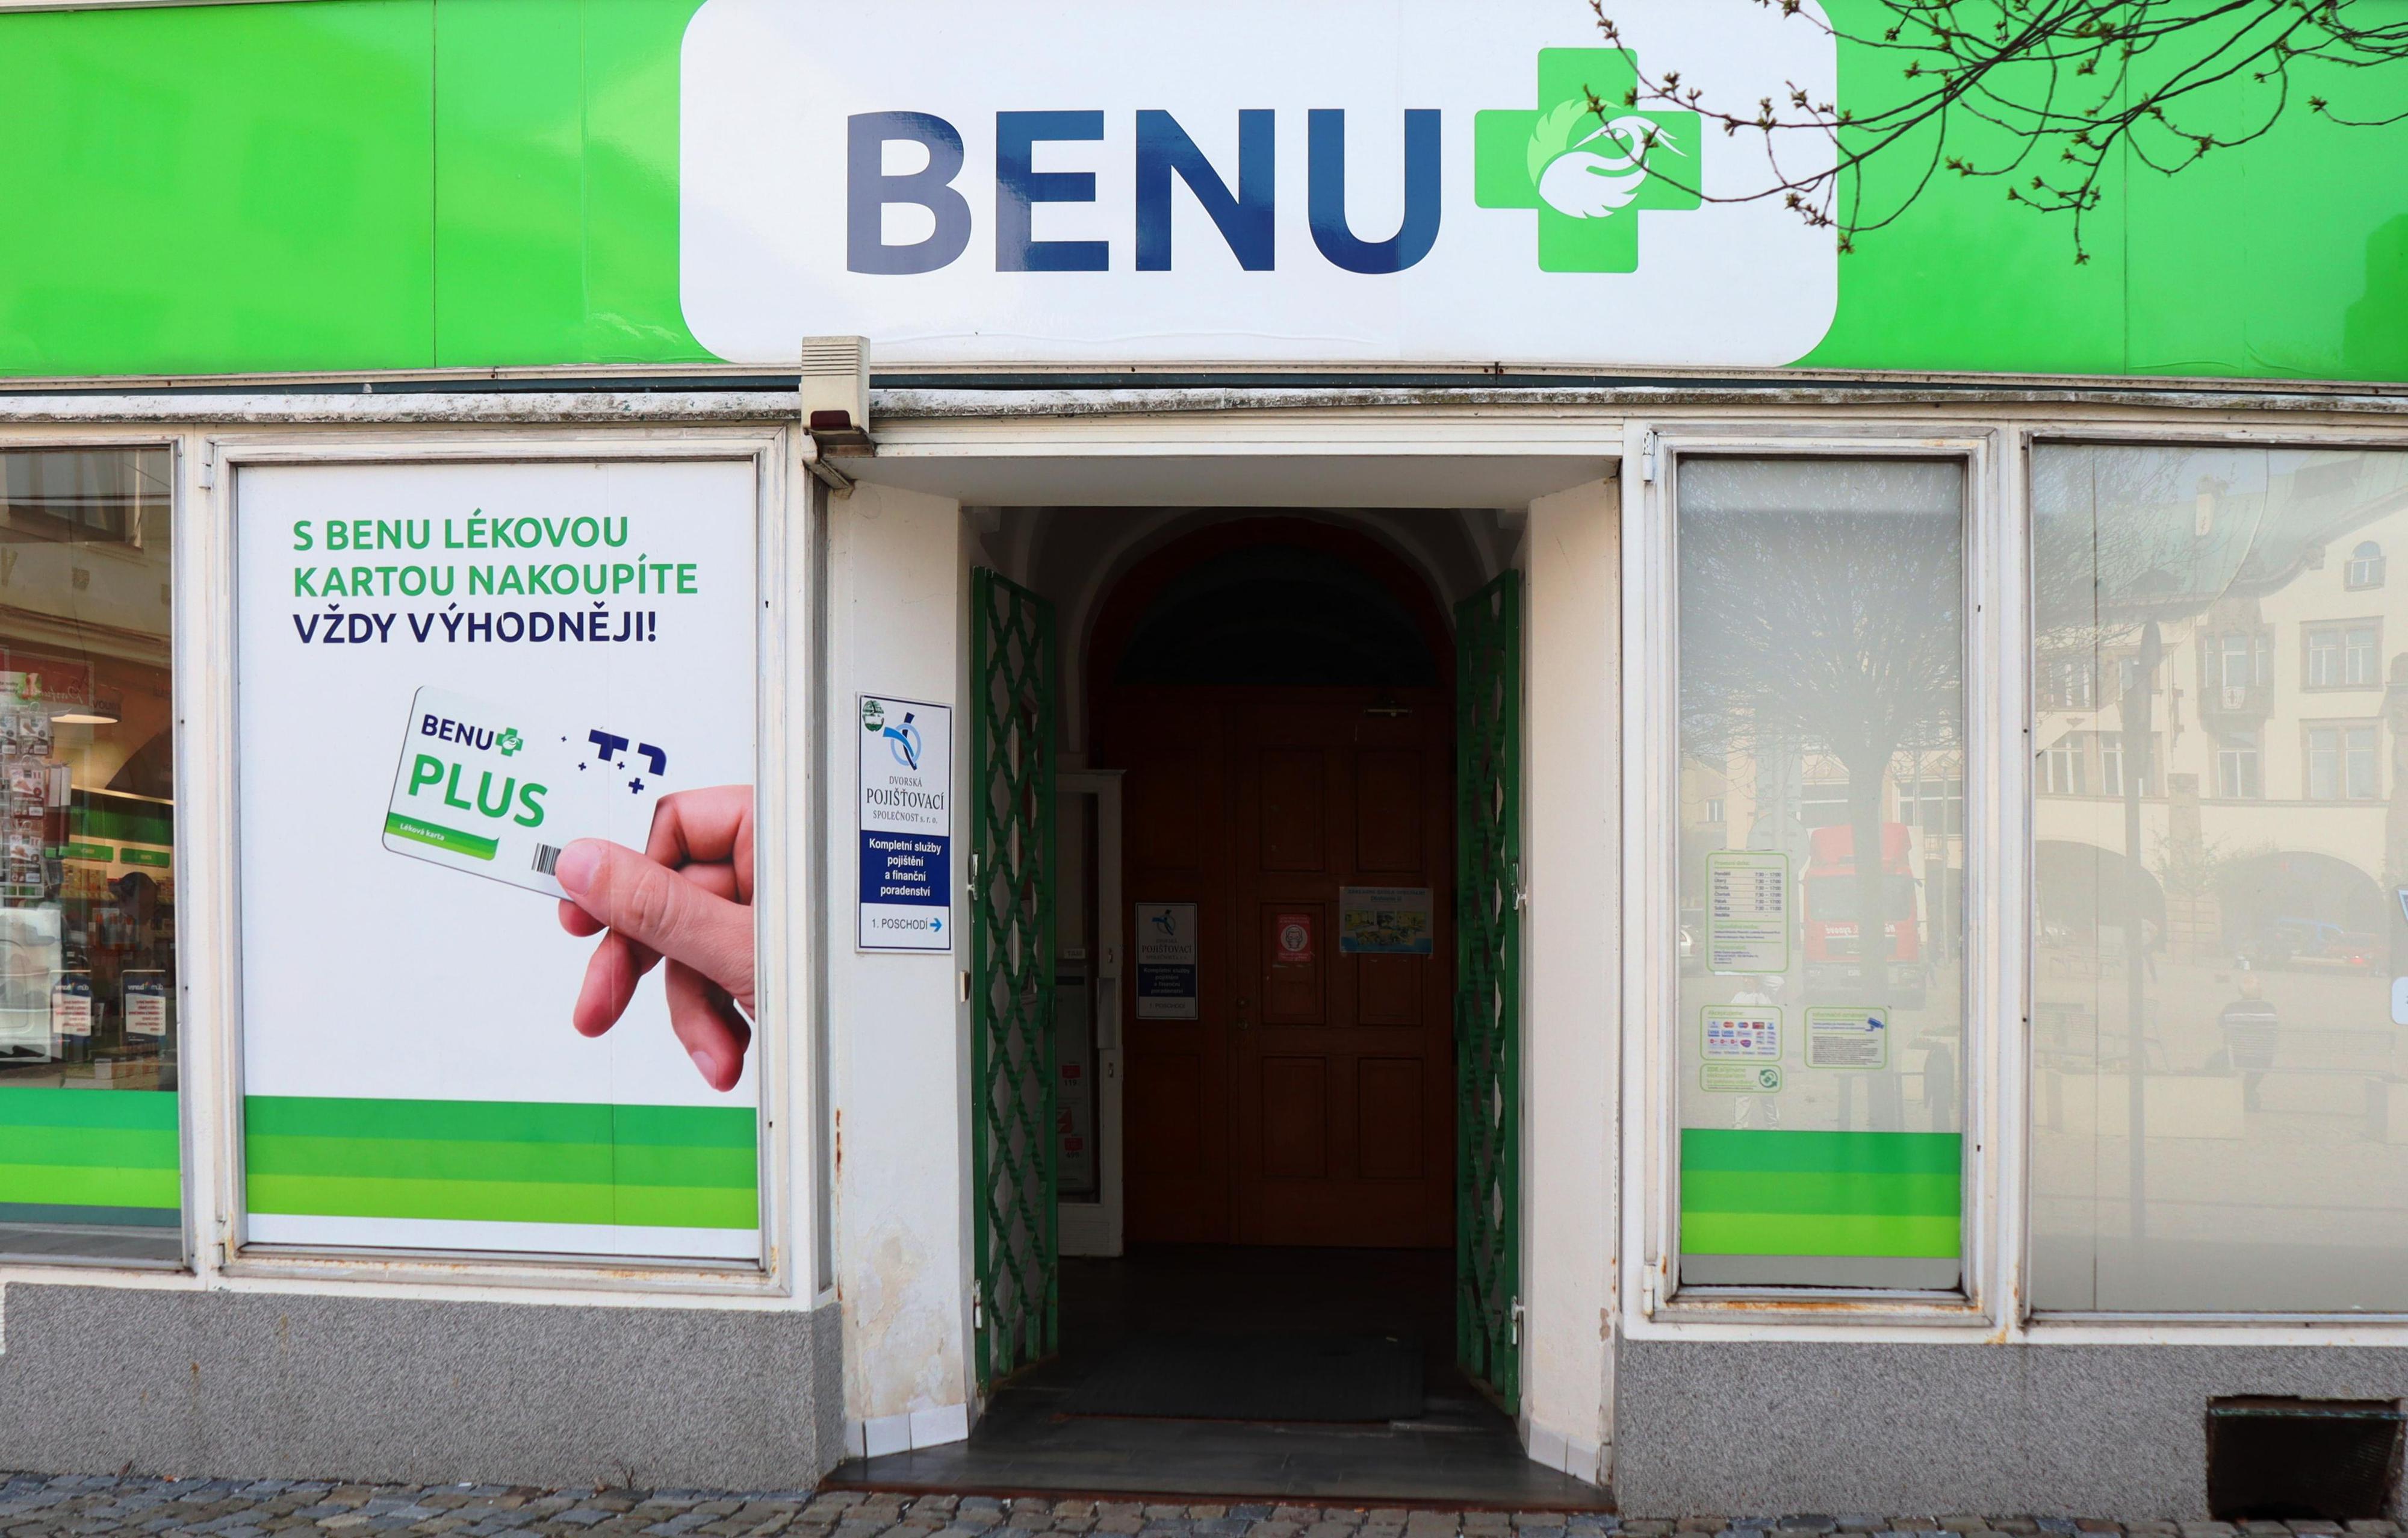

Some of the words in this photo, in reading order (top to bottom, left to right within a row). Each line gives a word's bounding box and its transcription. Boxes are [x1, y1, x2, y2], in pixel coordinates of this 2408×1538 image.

[847, 108, 1441, 275] BENU
[293, 520, 313, 551] S
[326, 519, 430, 550] BENU
[444, 507, 628, 549] LÉKOVOU
[294, 565, 455, 597] KARTOU
[468, 552, 698, 596] NAKOUPÍTE
[292, 603, 397, 644] VŽDY
[407, 601, 657, 643] VÝHODNĚJI!
[421, 714, 494, 751] BENU
[889, 775, 922, 787] DVORSKÁ
[408, 753, 548, 828] PLUS
[866, 787, 944, 810] POJIŠŤOVACÍ
[873, 810, 919, 823] SPOLEČNOST
[426, 829, 445, 841] karta
[869, 838, 912, 852] Kompletní
[914, 842, 942, 855] služby
[887, 855, 923, 868] pojištění
[885, 871, 890, 880] a
[893, 870, 926, 882] finanční
[880, 885, 931, 897] poradenství
[872, 919, 879, 928] 1.
[881, 917, 928, 930] POSCHODÍ
